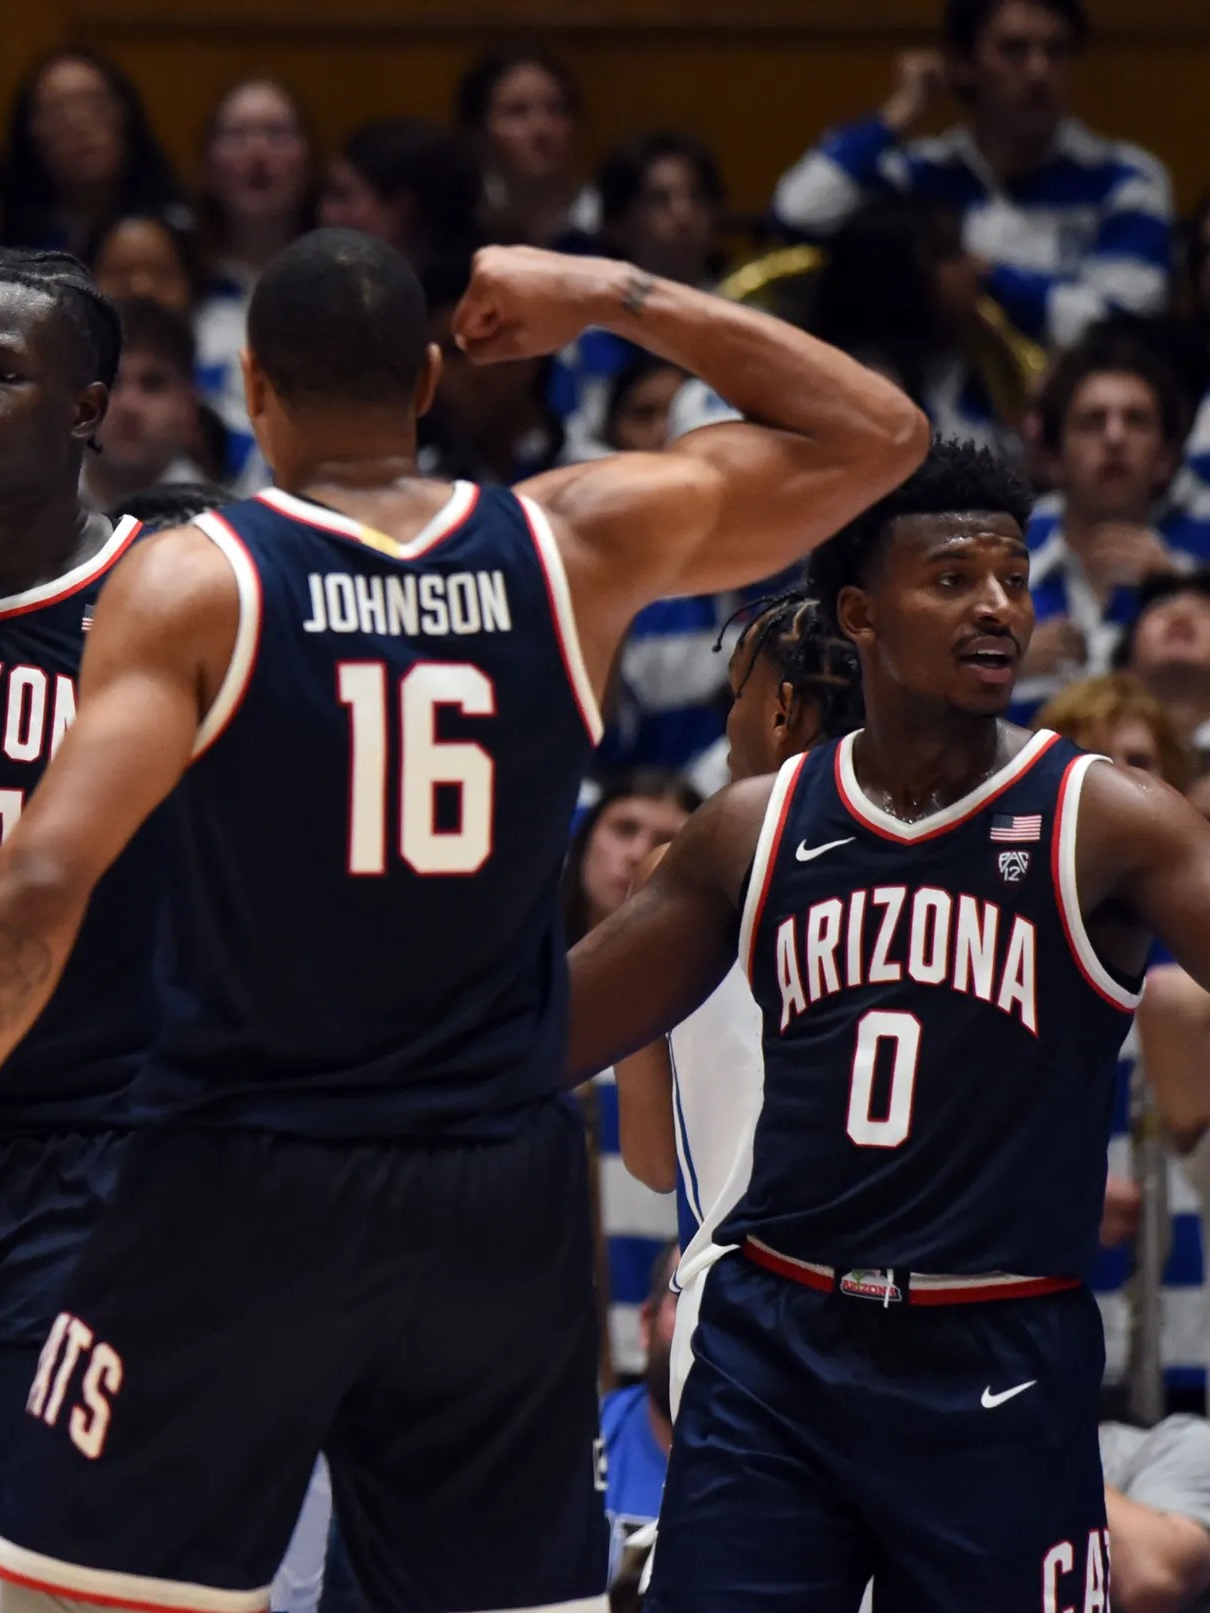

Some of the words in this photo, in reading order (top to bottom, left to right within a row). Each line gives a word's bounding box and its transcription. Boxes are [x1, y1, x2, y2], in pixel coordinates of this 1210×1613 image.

[303, 570, 512, 636] JOHNSON
[336, 658, 497, 878] 16
[998, 851, 1030, 874] PAC
[1003, 866, 1021, 881] 12
[776, 884, 1039, 1039] ARIZONA
[846, 1008, 922, 1148] 0
[1042, 1528, 1111, 1613] CA
